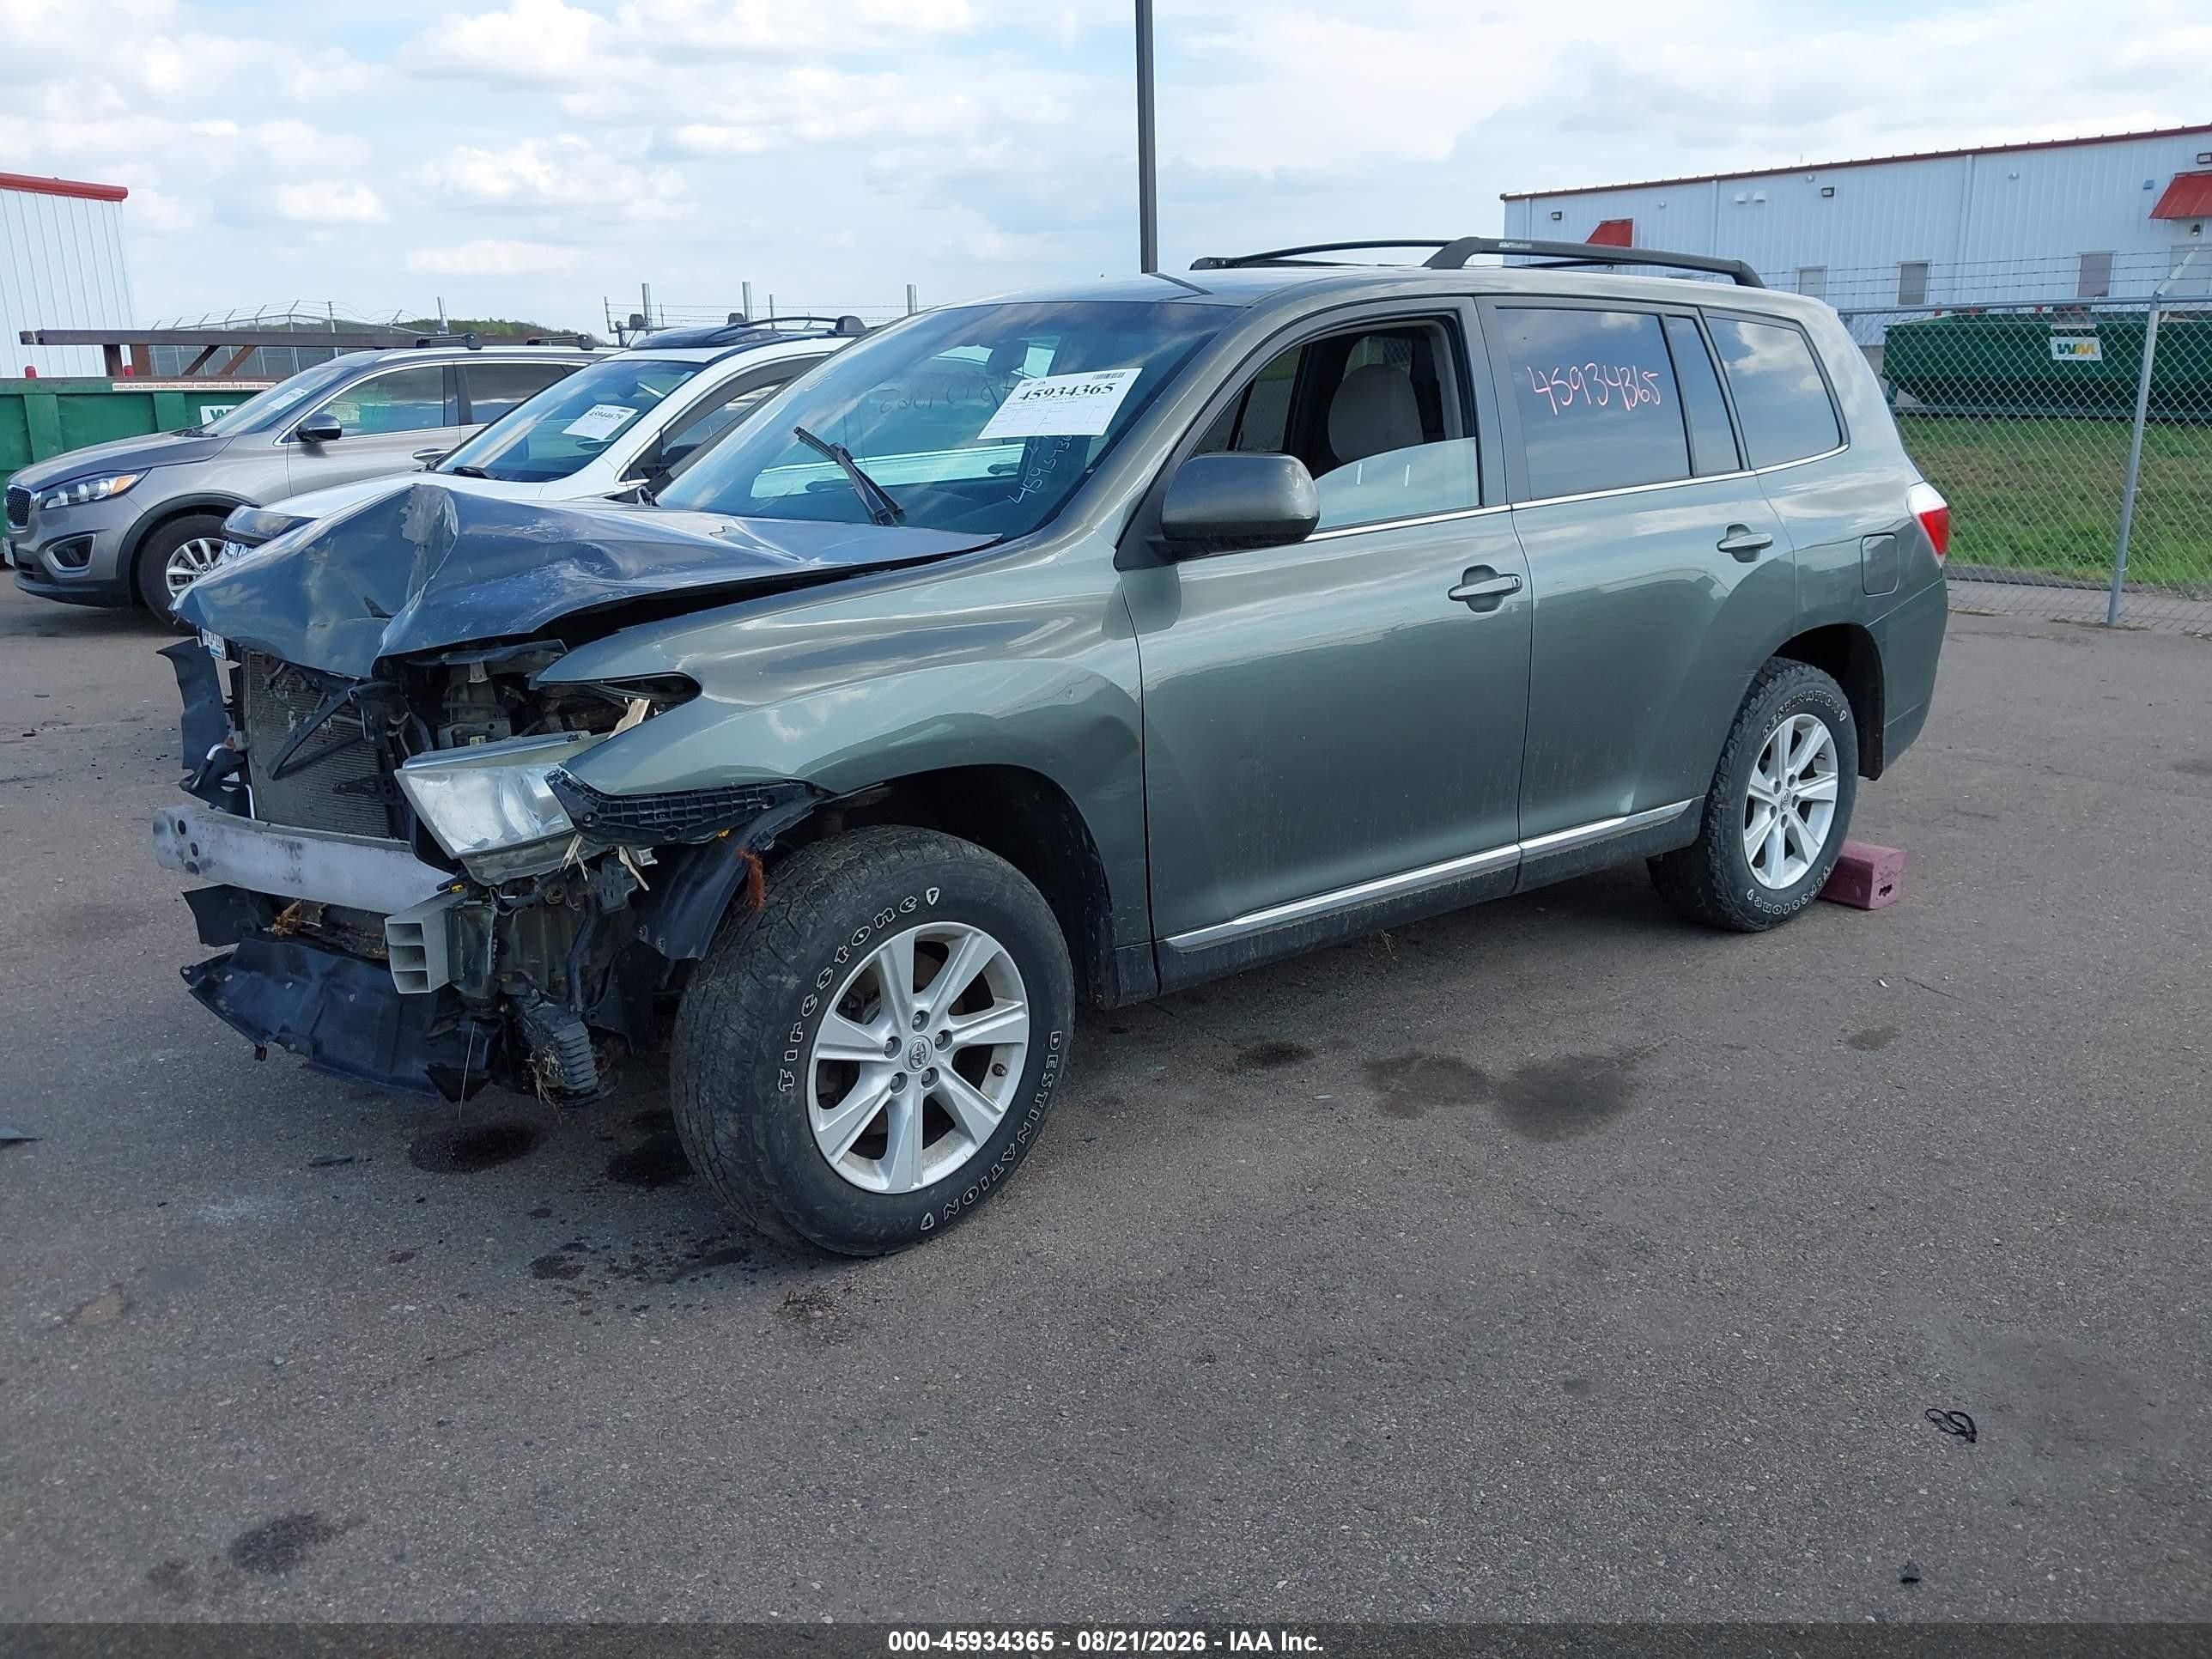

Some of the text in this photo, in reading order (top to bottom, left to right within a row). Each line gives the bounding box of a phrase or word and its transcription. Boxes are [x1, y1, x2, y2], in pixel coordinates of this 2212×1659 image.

[2057, 343, 2096, 354] WM
[1018, 383, 1116, 400] 45934365
[1527, 362, 1661, 416] 45934365
[1762, 690, 1841, 739] DESTINATION
[777, 896, 918, 1092] Firestone
[944, 1030, 1062, 1222] DESTINATION
